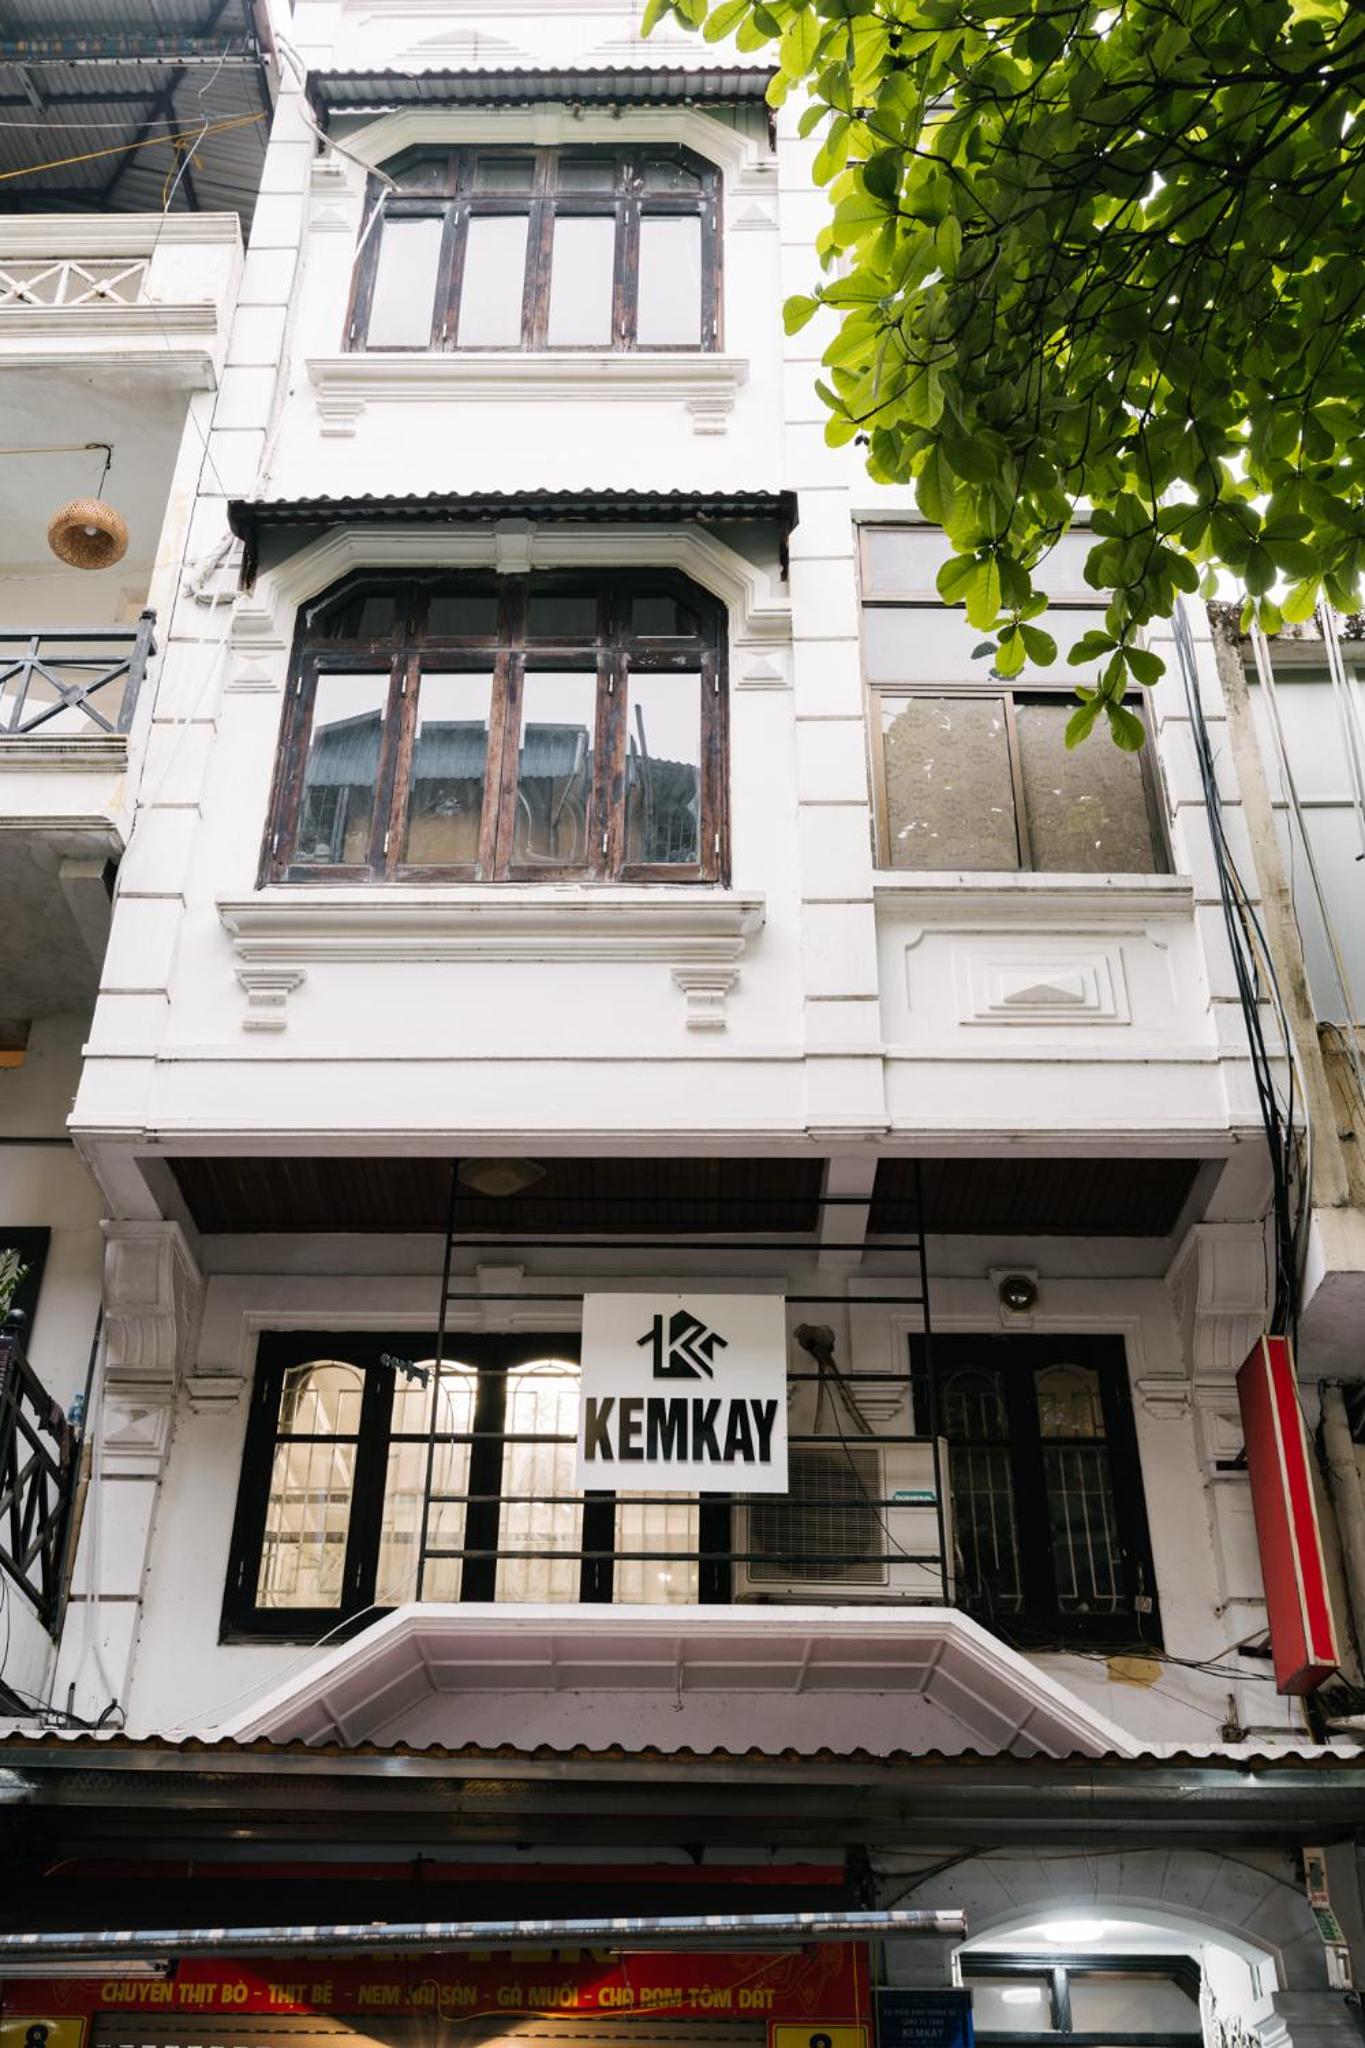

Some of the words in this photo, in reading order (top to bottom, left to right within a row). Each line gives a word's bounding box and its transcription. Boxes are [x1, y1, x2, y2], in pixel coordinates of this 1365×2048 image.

[584, 1397, 779, 1463] KEMKAY
[101, 1980, 174, 2003] CHUYÊN
[178, 1984, 217, 2007] THỊT
[221, 1979, 248, 2003] BÒ
[268, 1984, 308, 2008] THỊT
[358, 1985, 400, 2005] NEM
[688, 1984, 732, 2008] TÔM
